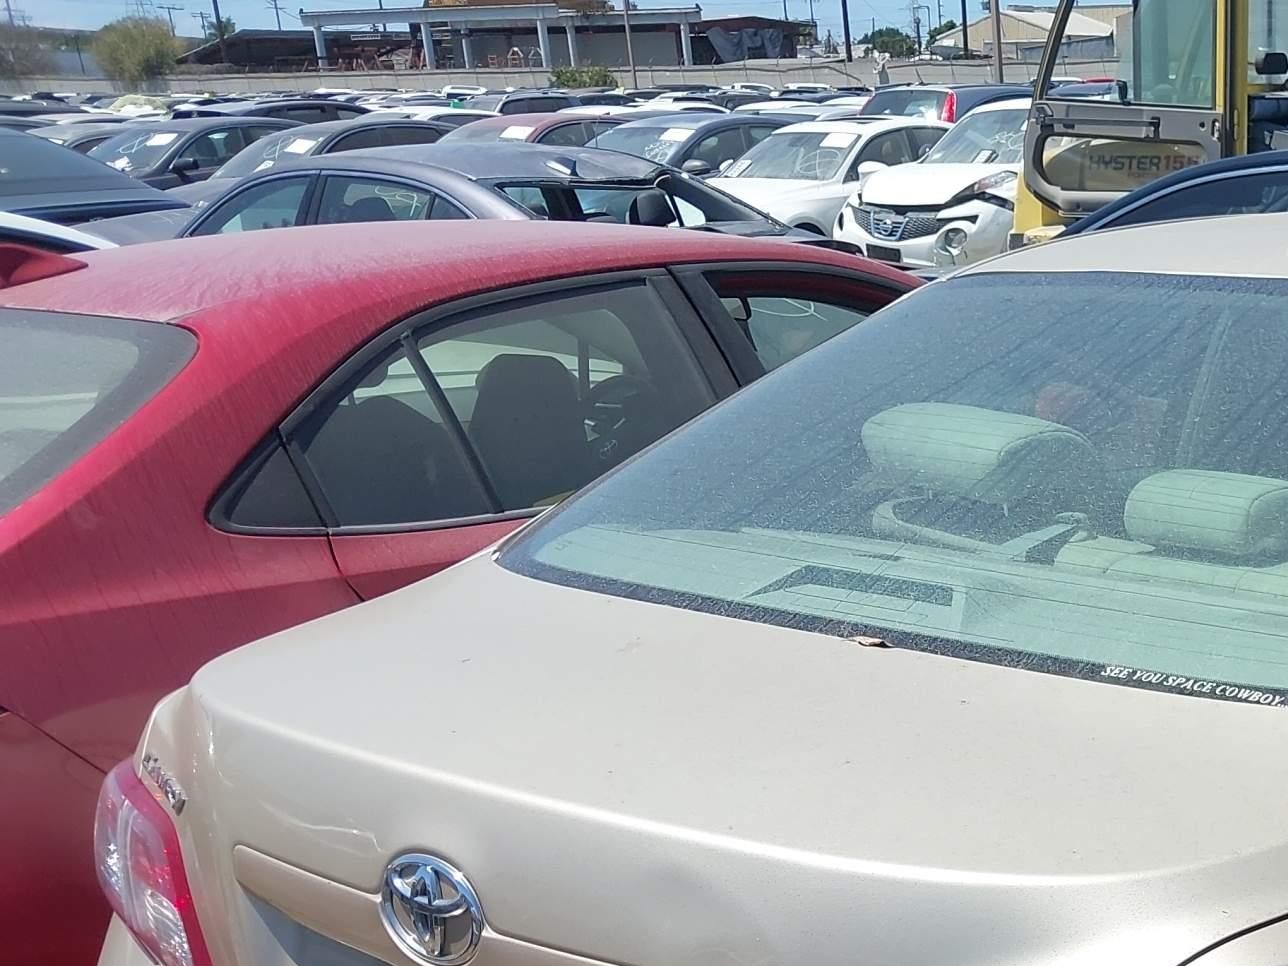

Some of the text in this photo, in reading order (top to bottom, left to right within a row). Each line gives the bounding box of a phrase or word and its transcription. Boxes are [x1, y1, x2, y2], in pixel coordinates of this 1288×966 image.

[1089, 155, 1160, 171] HYSTER
[1101, 666, 1132, 679] SEE
[1133, 670, 1166, 684] YOU
[1164, 676, 1216, 693] SPACE
